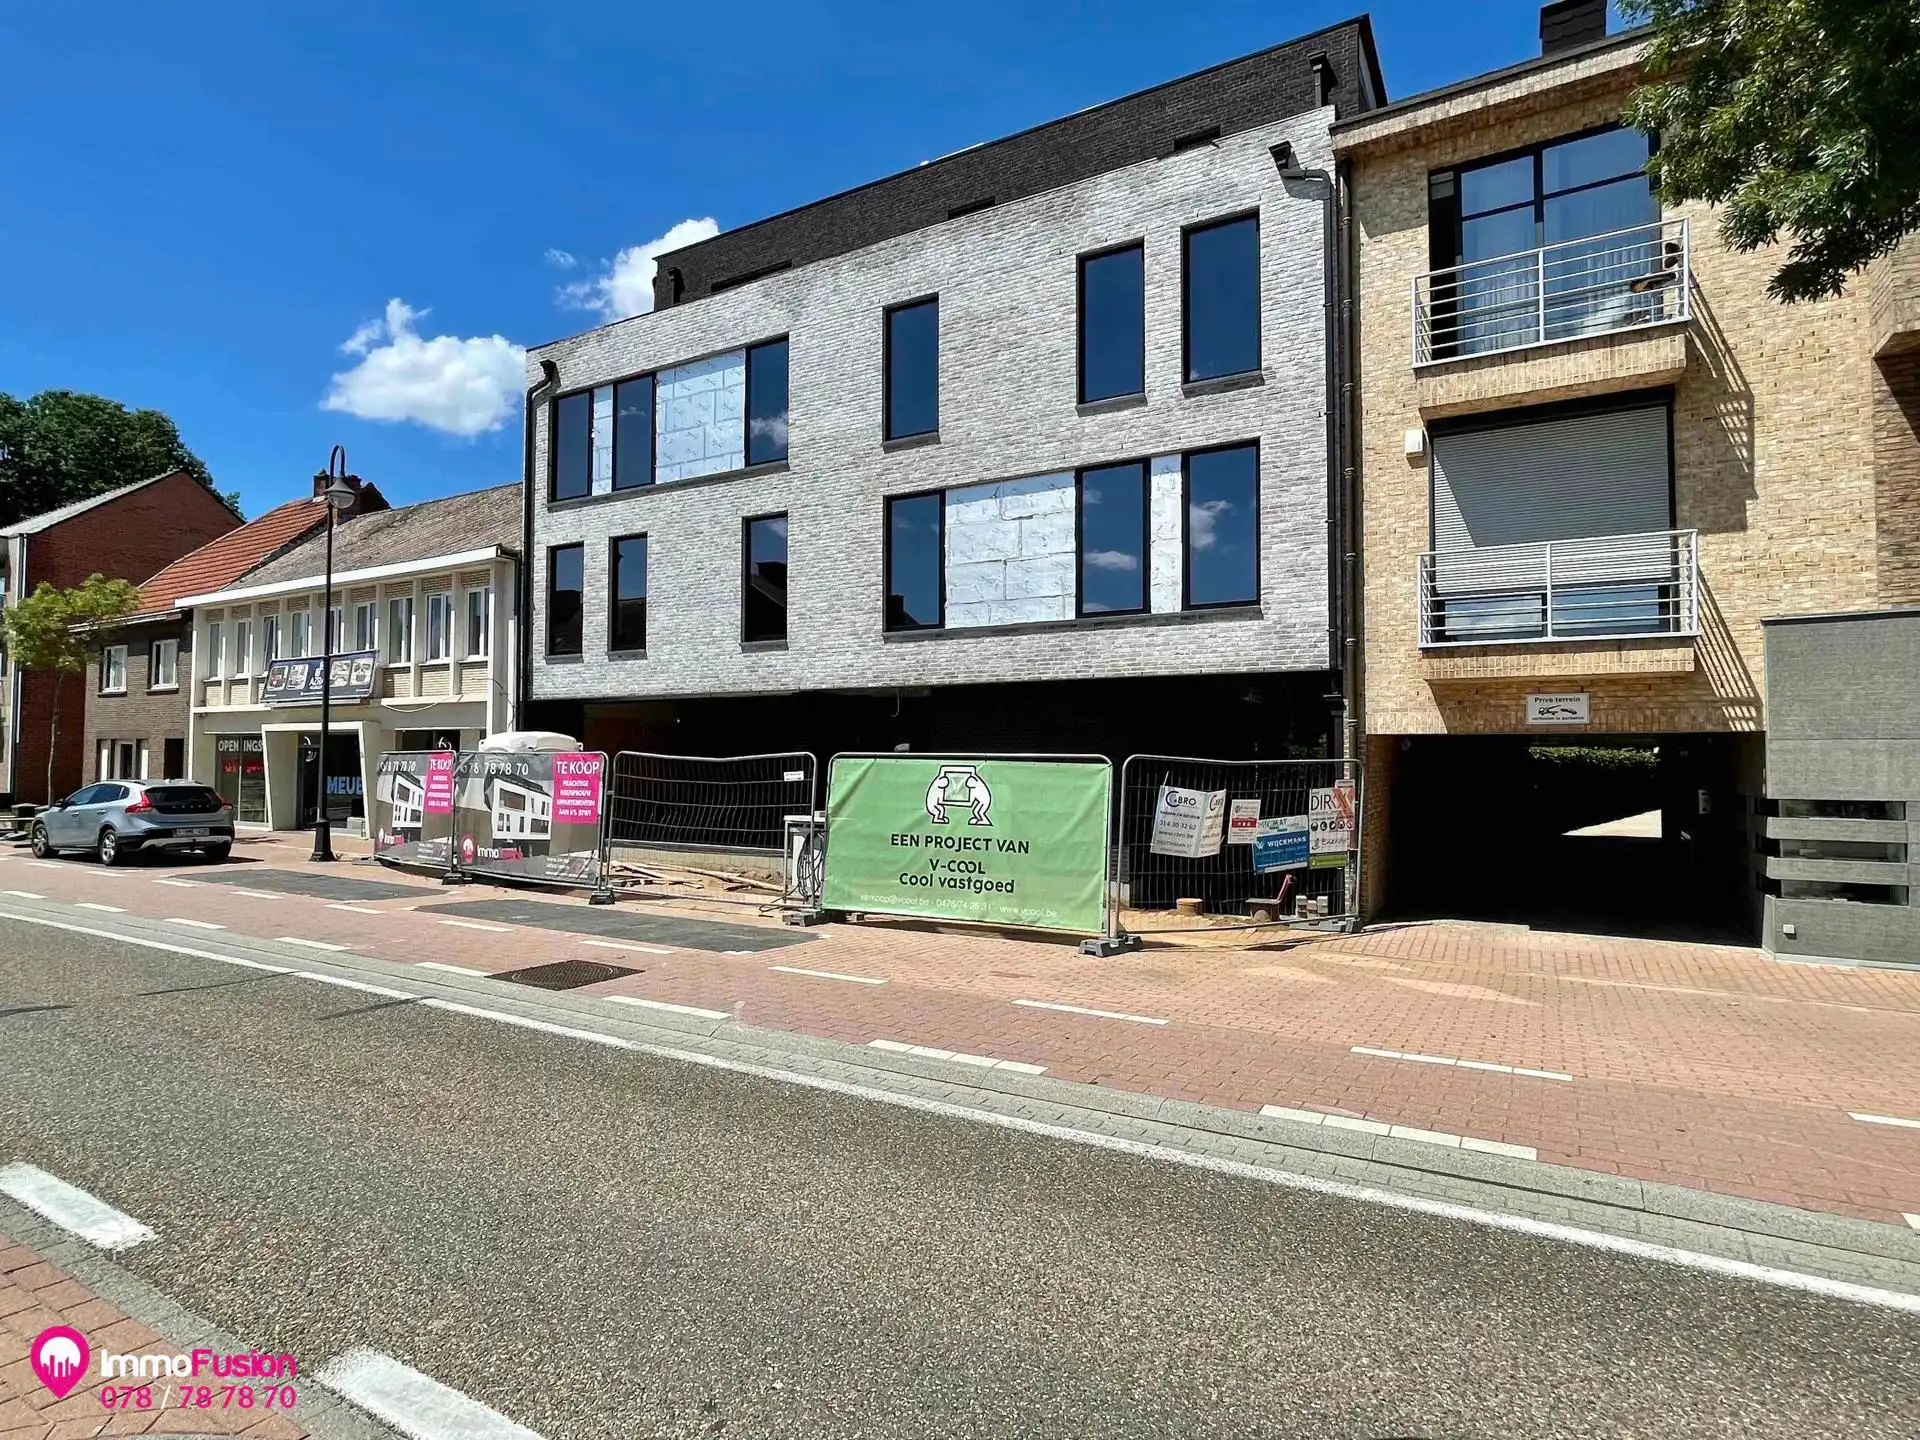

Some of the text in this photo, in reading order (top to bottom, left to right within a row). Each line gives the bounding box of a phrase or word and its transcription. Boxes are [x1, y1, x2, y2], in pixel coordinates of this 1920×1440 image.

[1555, 695, 1581, 703] terrein
[484, 761, 496, 775] 78
[499, 761, 512, 775] 78
[517, 762, 529, 776] 70
[556, 761, 599, 775] TE KOOP
[890, 834, 1029, 854] EEN PROJECT VAN
[929, 858, 986, 875] V-COOL
[899, 872, 1015, 894] Cool vastgoed
